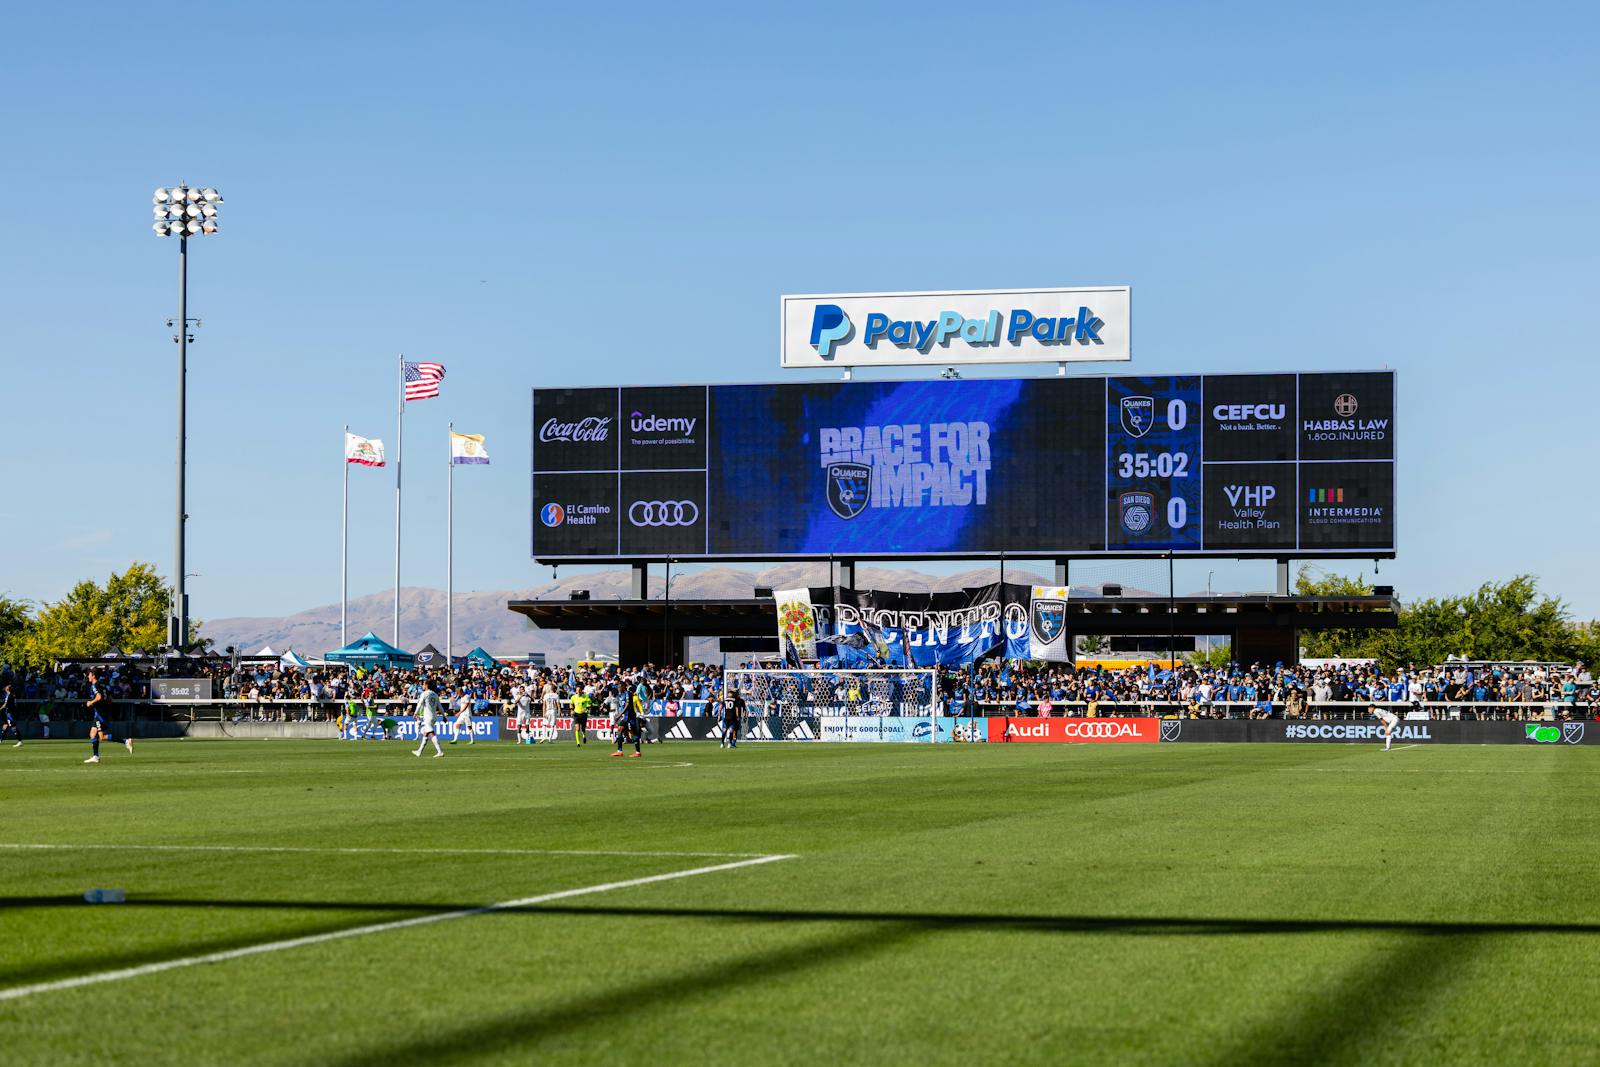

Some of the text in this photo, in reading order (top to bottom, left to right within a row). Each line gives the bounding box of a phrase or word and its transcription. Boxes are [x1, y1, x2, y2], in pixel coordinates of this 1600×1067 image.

[863, 307, 1104, 354] PayPal Park
[1167, 398, 1187, 431] 0
[1212, 404, 1286, 420] CEFCU
[540, 417, 612, 442] Coca-Cola
[630, 414, 696, 436] udemy
[1303, 419, 1388, 430] HABBAS LAW
[820, 422, 990, 468] BRACE FOR
[1118, 452, 1188, 478] 35:02
[832, 468, 868, 478] QUAKES
[872, 460, 992, 508] IMPACT
[1124, 496, 1150, 504] SAN DIEGO
[1224, 485, 1276, 506] VHP
[566, 504, 610, 514] El Camino
[1167, 497, 1187, 528] 0
[1233, 508, 1266, 519] Valley
[1309, 508, 1381, 516] INTERMEDIA
[566, 516, 596, 524] Health
[1218, 520, 1280, 529] Health Plan
[725, 701, 734, 710] 10
[1006, 722, 1050, 736] Audi
[1286, 724, 1431, 739] #SOCCERFORALL
